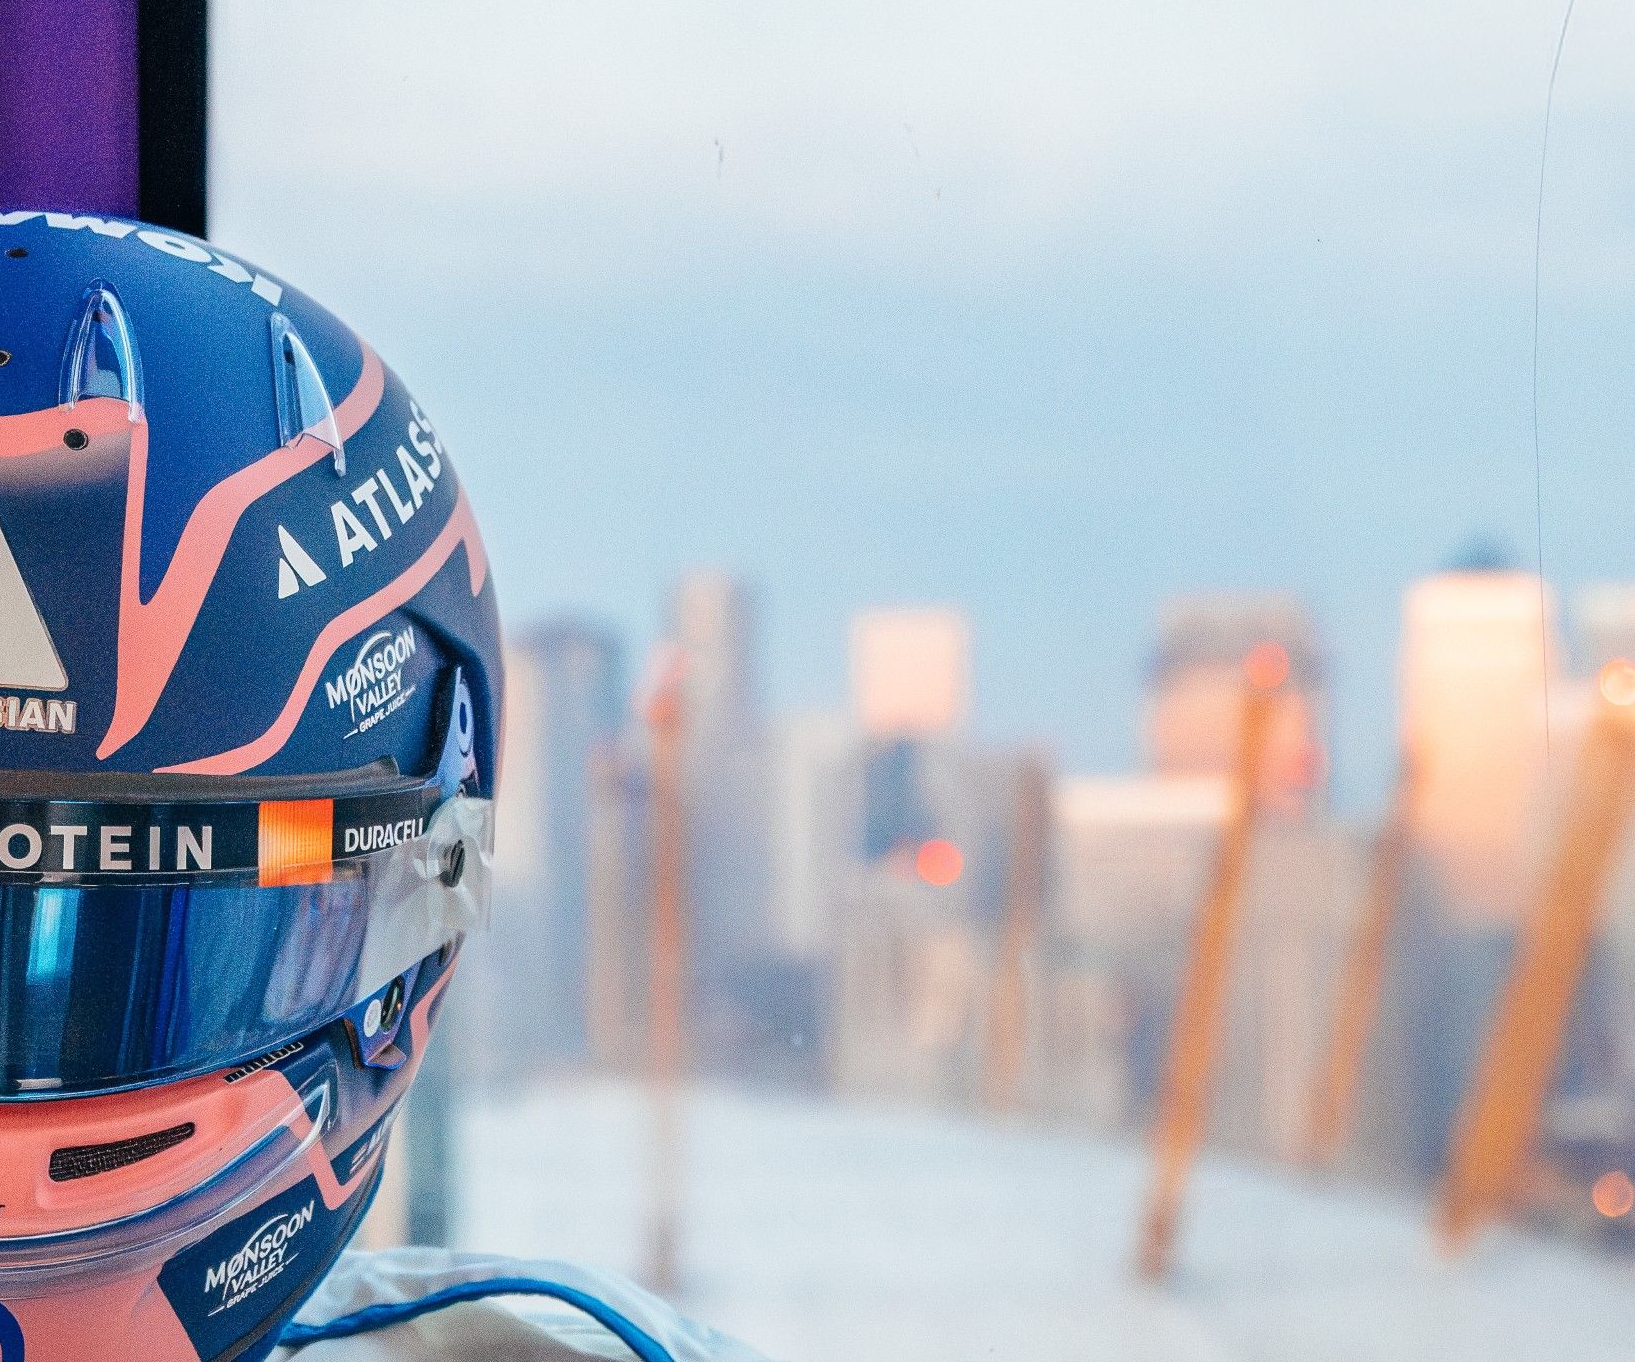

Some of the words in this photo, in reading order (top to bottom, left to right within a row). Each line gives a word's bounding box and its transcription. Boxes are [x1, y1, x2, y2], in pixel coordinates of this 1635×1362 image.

[325, 625, 417, 709] MONSOON
[356, 669, 402, 715] VALLEY
[204, 1199, 315, 1294] MONSOON
[231, 1241, 289, 1294] VALLEY
